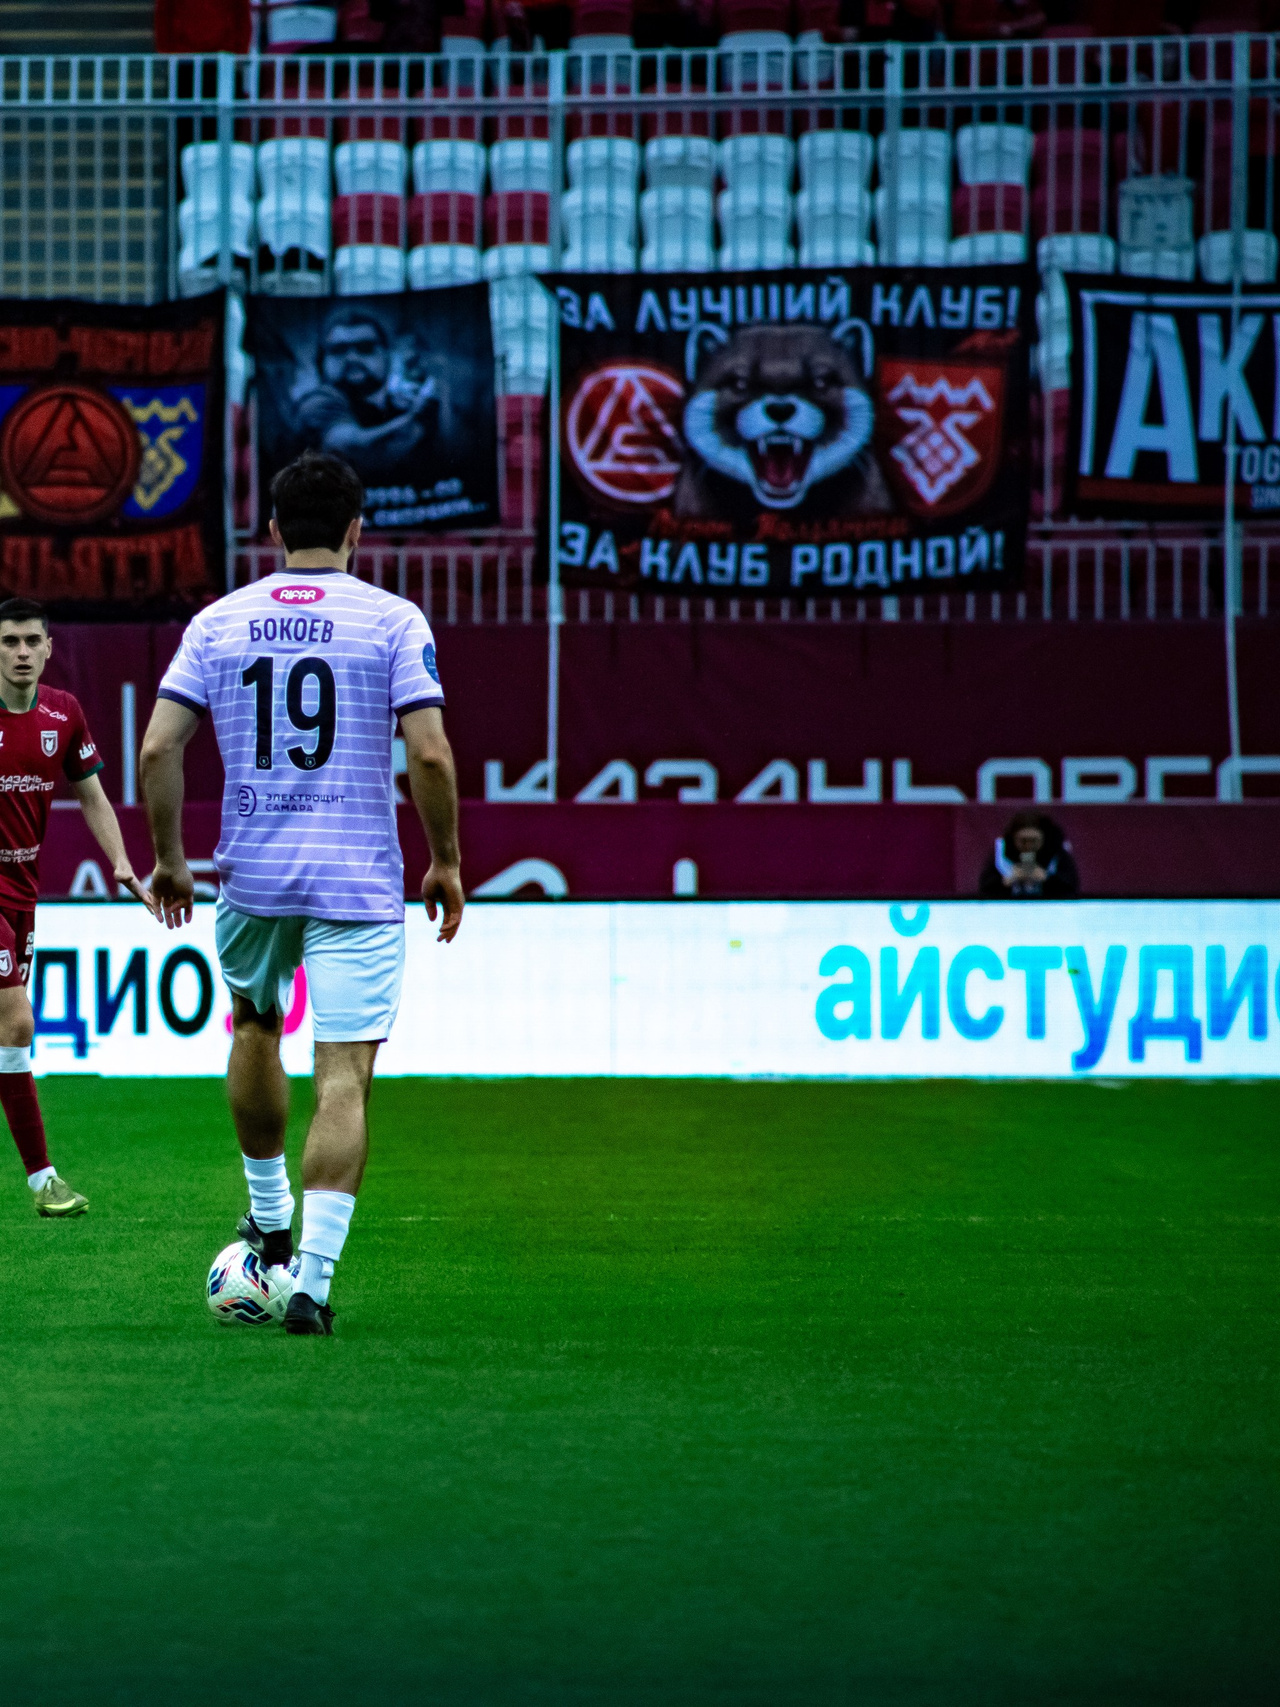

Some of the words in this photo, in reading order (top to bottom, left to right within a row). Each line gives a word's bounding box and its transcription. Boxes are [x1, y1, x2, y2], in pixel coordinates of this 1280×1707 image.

[555, 285, 616, 332] ЗА
[635, 276, 852, 333] ЛУЧШИЙ
[871, 285, 1019, 331] КЛУБ!
[557, 522, 619, 573] ЗА
[640, 537, 770, 587] КЛУБ
[790, 526, 1006, 589] РОДНОЙ!
[279, 588, 317, 601] RIFAR
[248, 617, 335, 644] БОКОЕВ
[241, 656, 338, 771] 19
[265, 792, 346, 804] ЭЛЕКТРОЩИТ
[265, 802, 314, 813] САМАРА
[815, 903, 1280, 1071] айстуди
